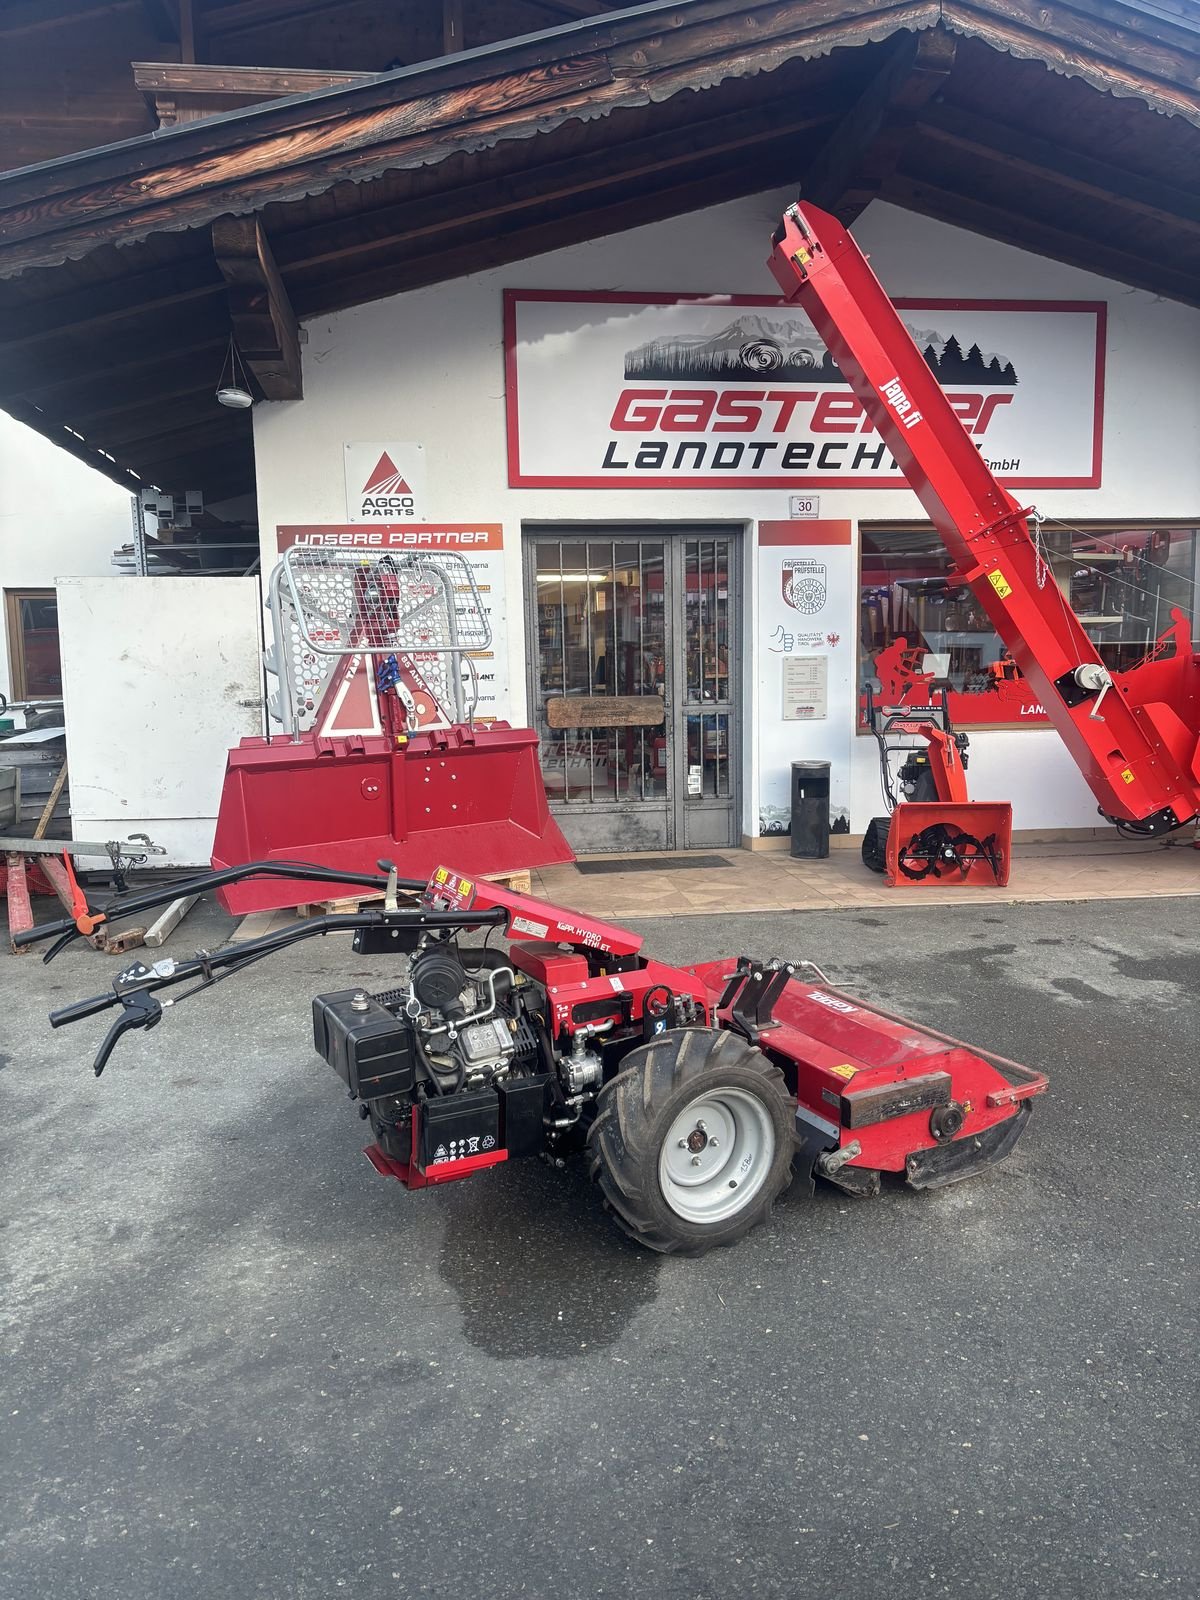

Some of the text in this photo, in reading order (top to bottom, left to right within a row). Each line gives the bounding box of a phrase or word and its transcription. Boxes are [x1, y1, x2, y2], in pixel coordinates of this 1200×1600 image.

[361, 497, 414, 508] AGCO
[798, 501, 812, 512] 30
[361, 508, 415, 516] PARTS
[794, 566, 825, 574] PRÜFSTELLE
[575, 928, 602, 942] HYDRO
